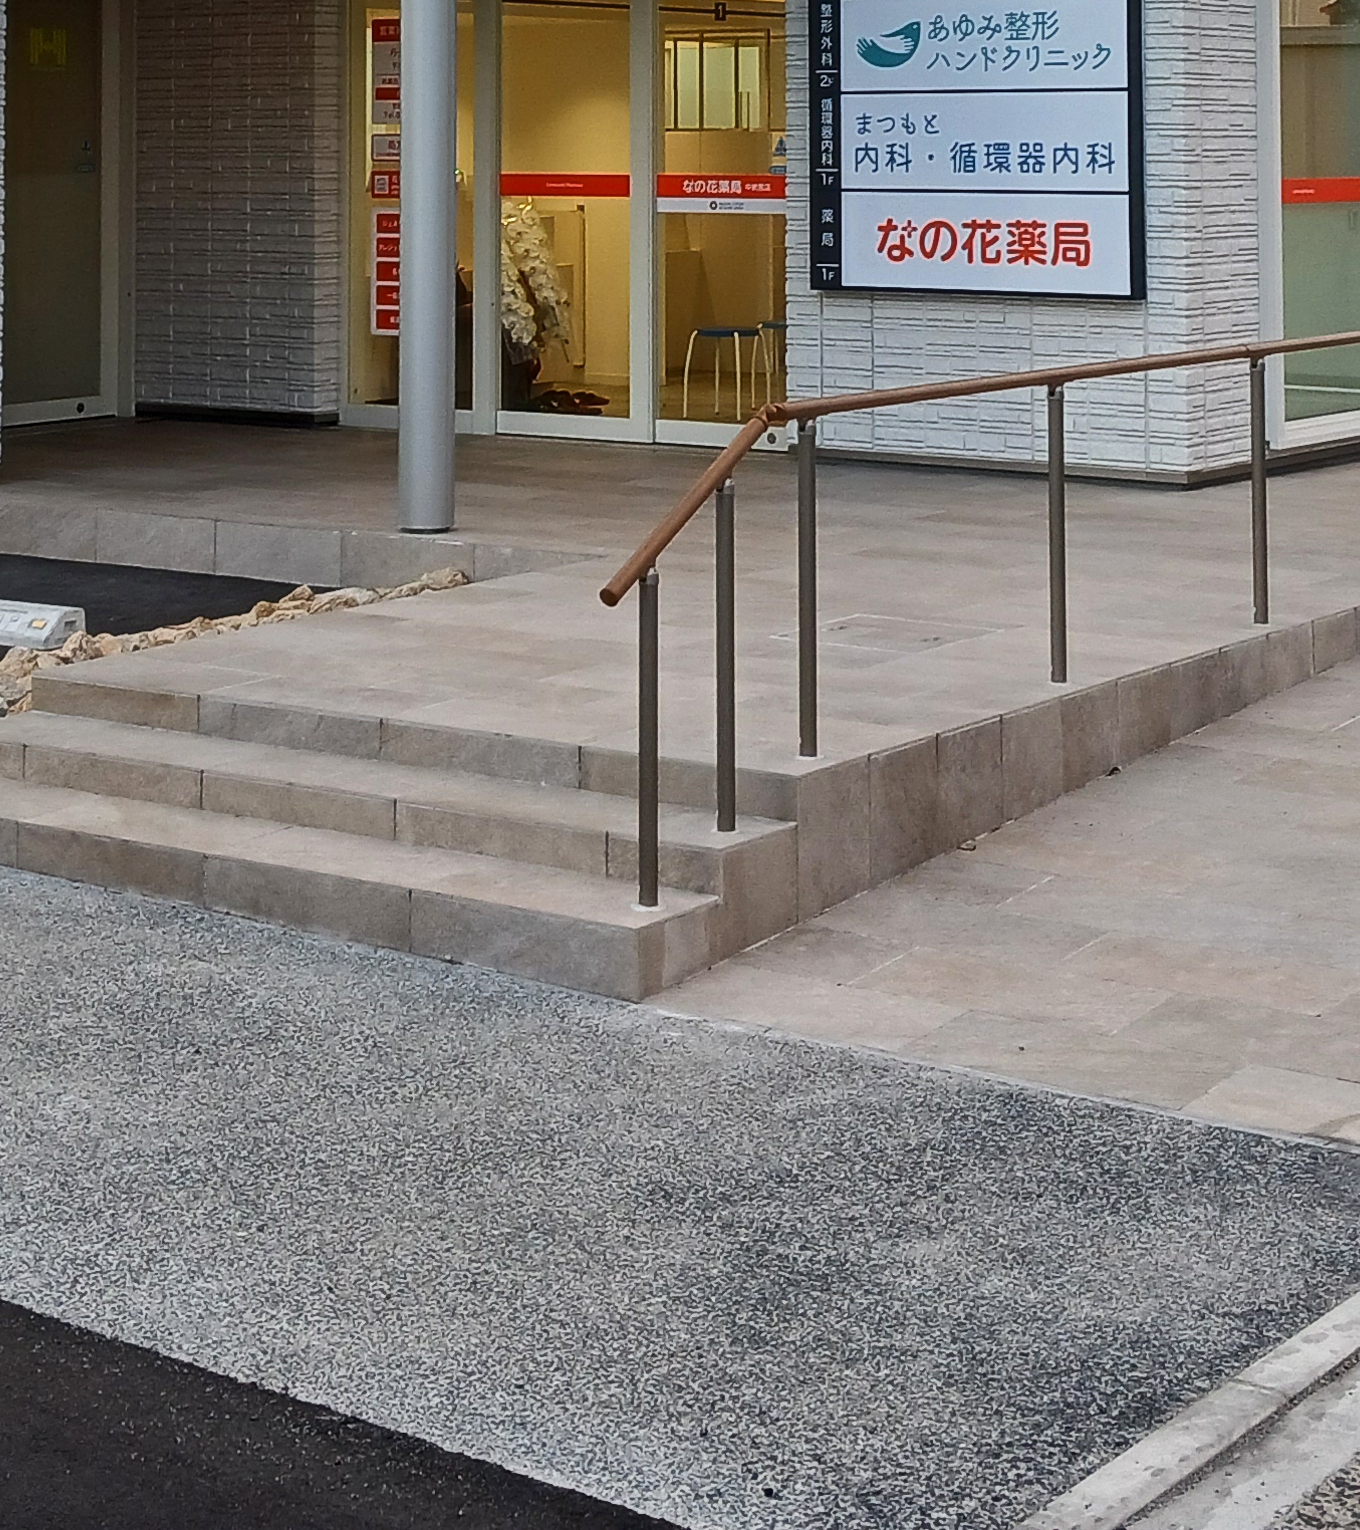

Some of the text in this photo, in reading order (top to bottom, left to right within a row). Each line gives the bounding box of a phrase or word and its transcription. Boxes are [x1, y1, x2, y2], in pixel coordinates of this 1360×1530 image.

[820, 3, 833, 67] 整形外科
[927, 10, 1060, 43] あゆみ整形
[926, 42, 1112, 72] ハンドクリニック
[820, 97, 834, 167] 循環器内科
[855, 113, 940, 135] まつもと
[854, 141, 1116, 175] 内科・循環器内科
[682, 179, 742, 195] なの花薬局
[821, 172, 835, 186] 1F
[821, 208, 834, 247] 薬局
[877, 218, 1091, 267] なの花薬局
[821, 267, 835, 282] 1F
